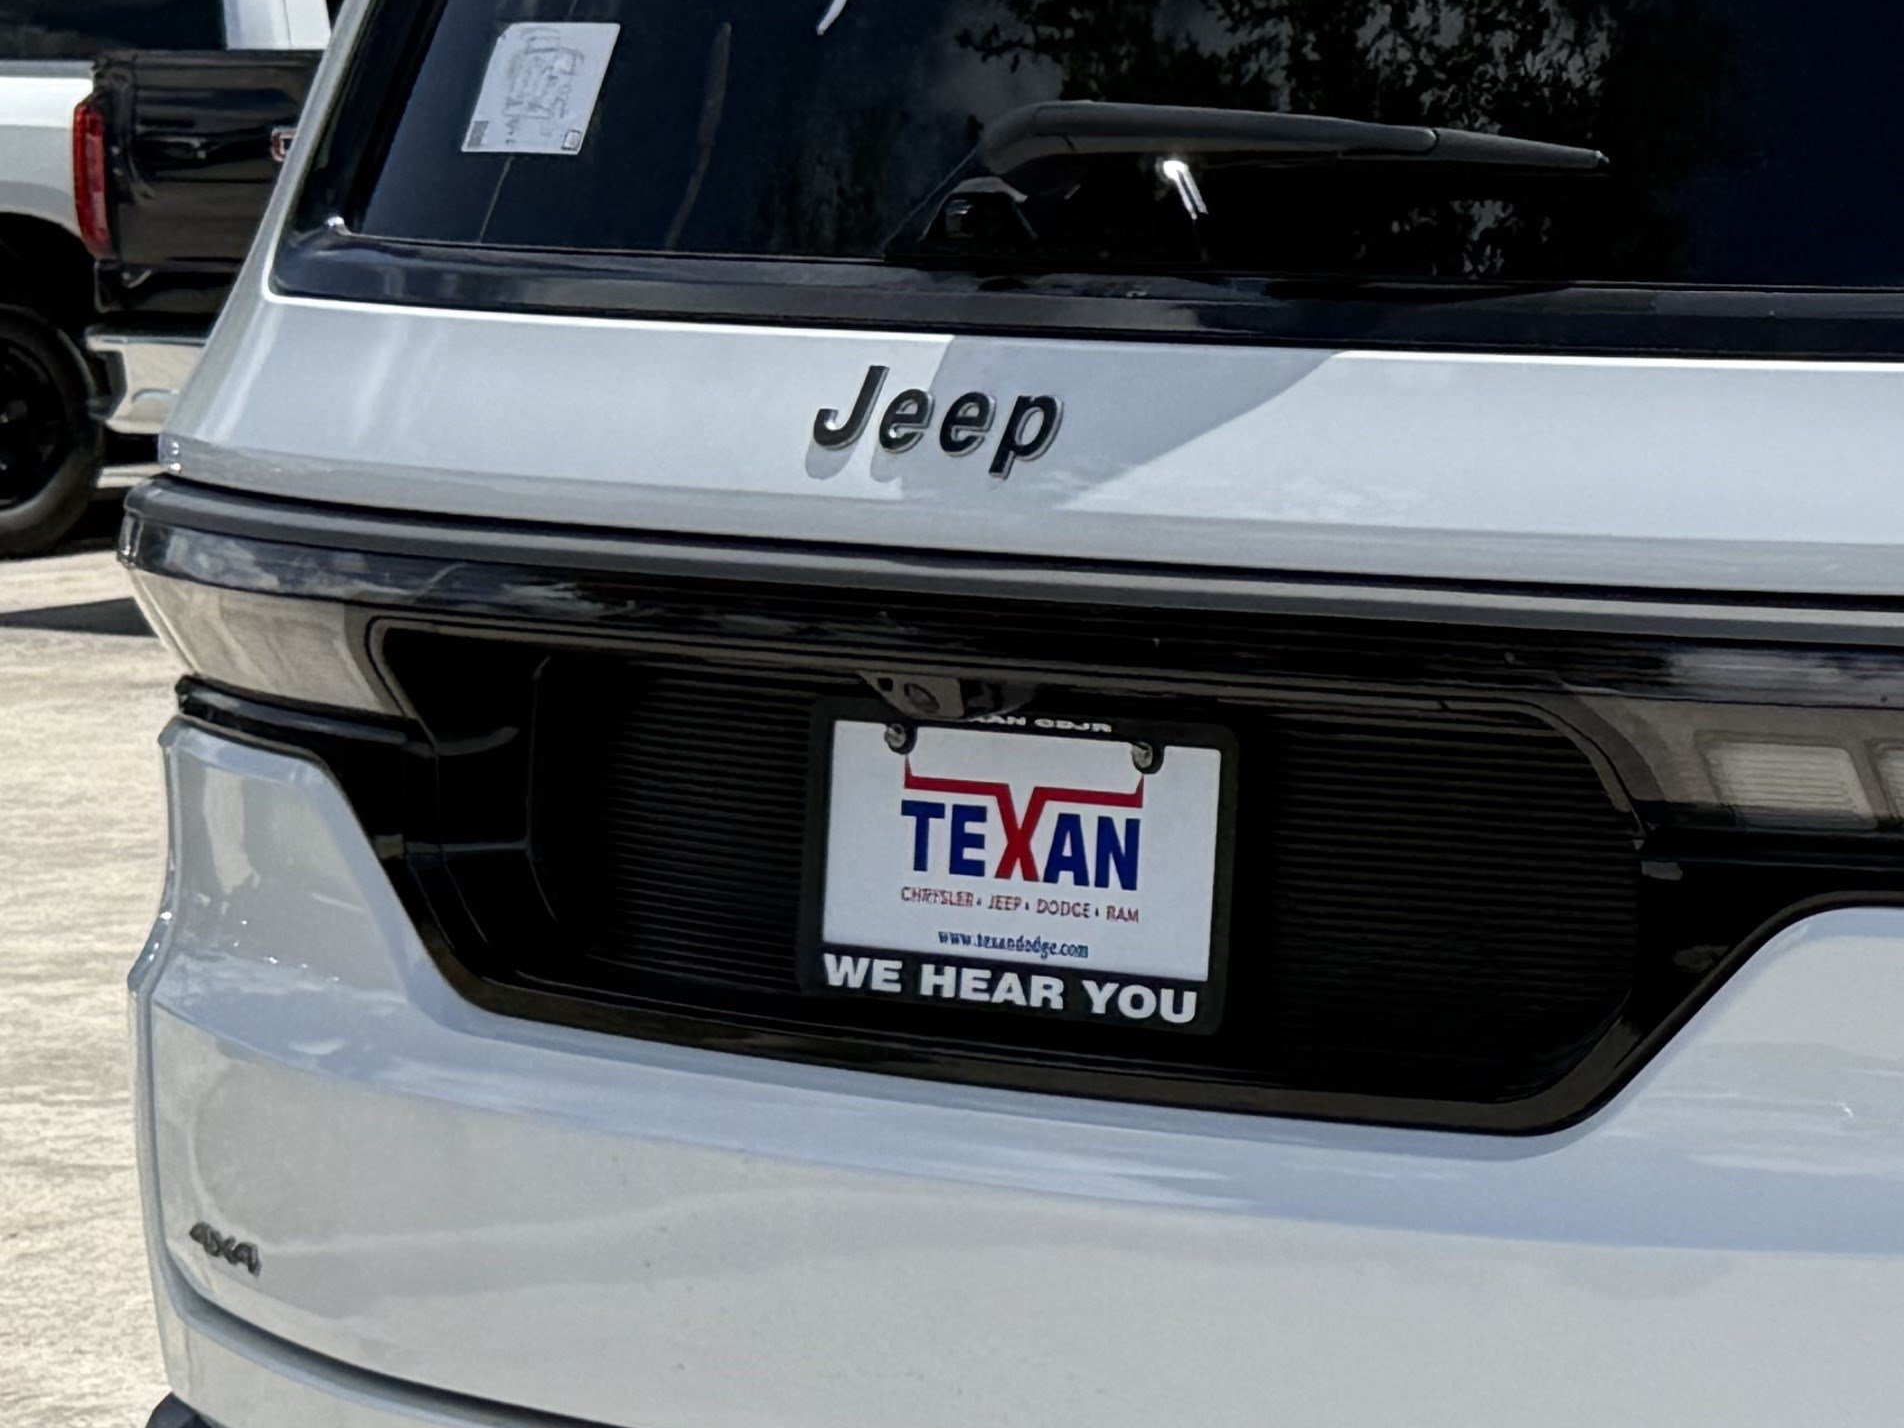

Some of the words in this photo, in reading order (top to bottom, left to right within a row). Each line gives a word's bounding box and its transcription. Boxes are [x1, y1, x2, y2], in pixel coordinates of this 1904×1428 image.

[812, 364, 1064, 481] Jeep
[901, 777, 1144, 891] TEXAN
[901, 885, 974, 909] CHRYSLER
[987, 894, 1022, 912] JEEP
[1035, 899, 1091, 920] DODGE
[1105, 904, 1140, 924] RAM
[823, 952, 904, 994] WE
[918, 963, 1064, 1010] HEAR
[1081, 979, 1198, 1025] YOU
